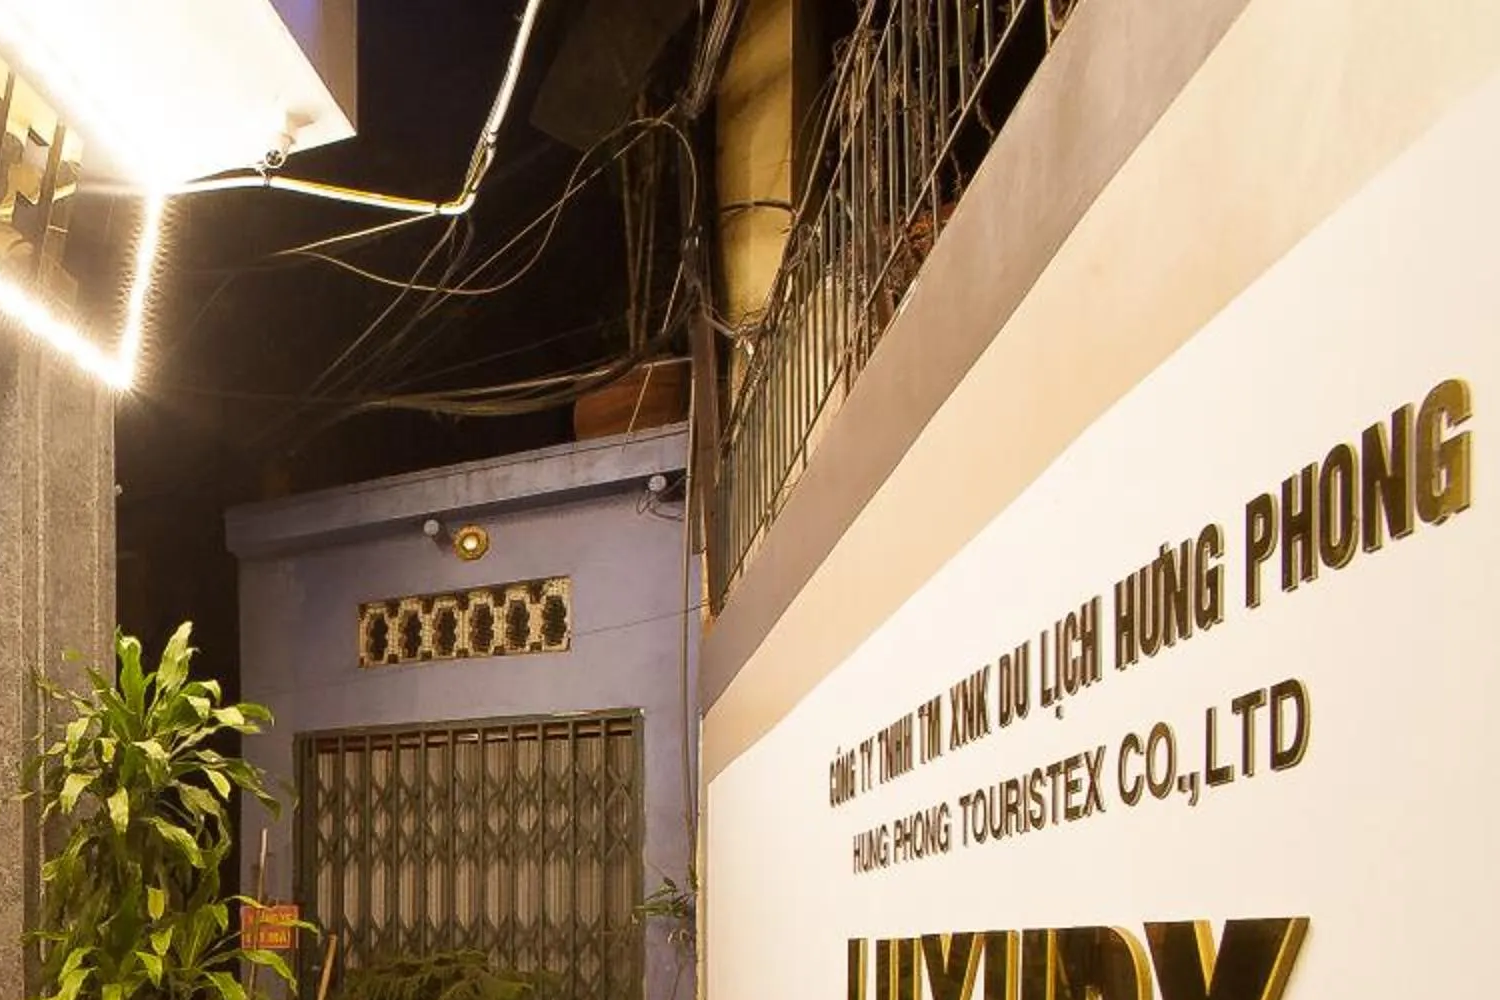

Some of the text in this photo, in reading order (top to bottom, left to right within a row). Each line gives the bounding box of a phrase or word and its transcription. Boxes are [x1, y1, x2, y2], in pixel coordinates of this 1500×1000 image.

[860, 736, 874, 792] TY
[878, 713, 914, 784] TNHH
[918, 694, 942, 764] TM
[950, 664, 991, 751] XNK
[999, 640, 1030, 728] DU
[1040, 595, 1102, 719] LỊCH
[1246, 379, 1472, 609] PHONG
[853, 824, 890, 874] HUNG
[894, 802, 952, 863] PHONG
[959, 745, 1106, 847] TOURISTEX
